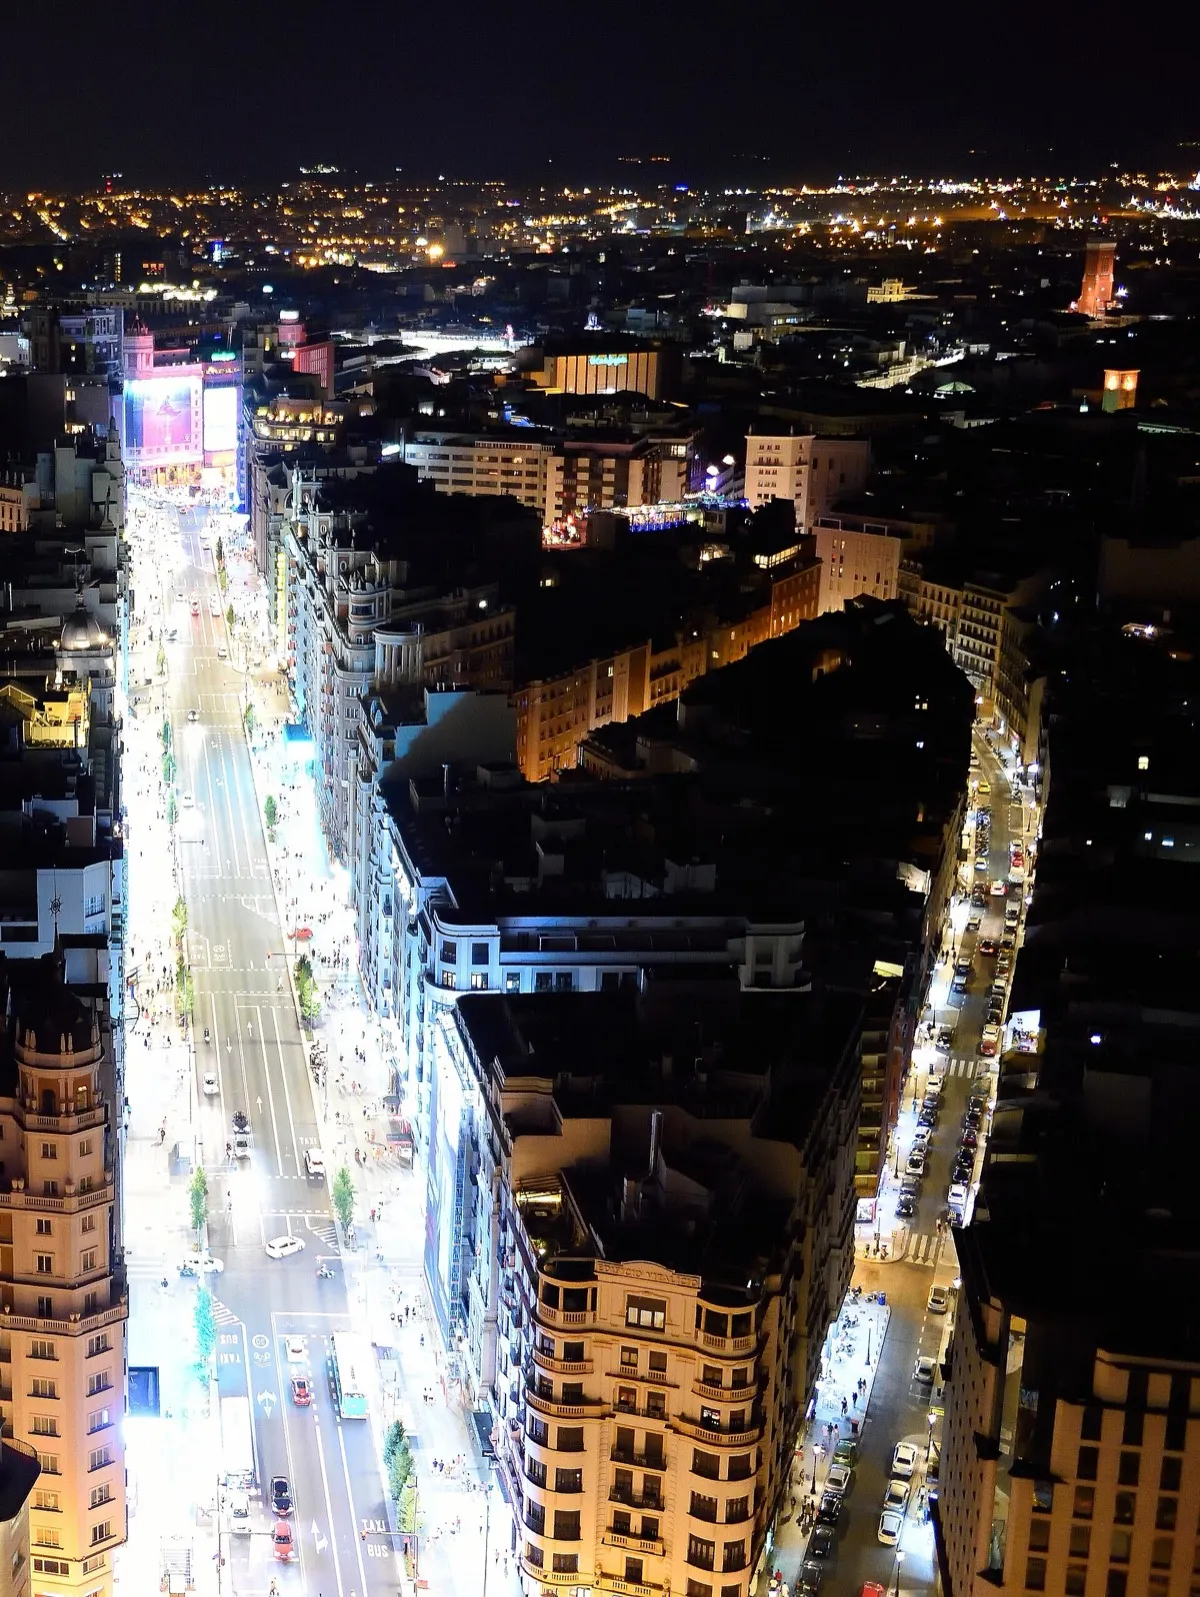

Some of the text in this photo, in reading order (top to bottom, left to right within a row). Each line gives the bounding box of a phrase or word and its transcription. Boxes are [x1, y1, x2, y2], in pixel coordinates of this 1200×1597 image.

[598, 1264, 698, 1287] EDIFICIO VITALICIO
[220, 1334, 238, 1345] BUS
[220, 1352, 240, 1363] TAXI
[361, 1519, 386, 1532] TAXI
[367, 1544, 389, 1557] BUS
